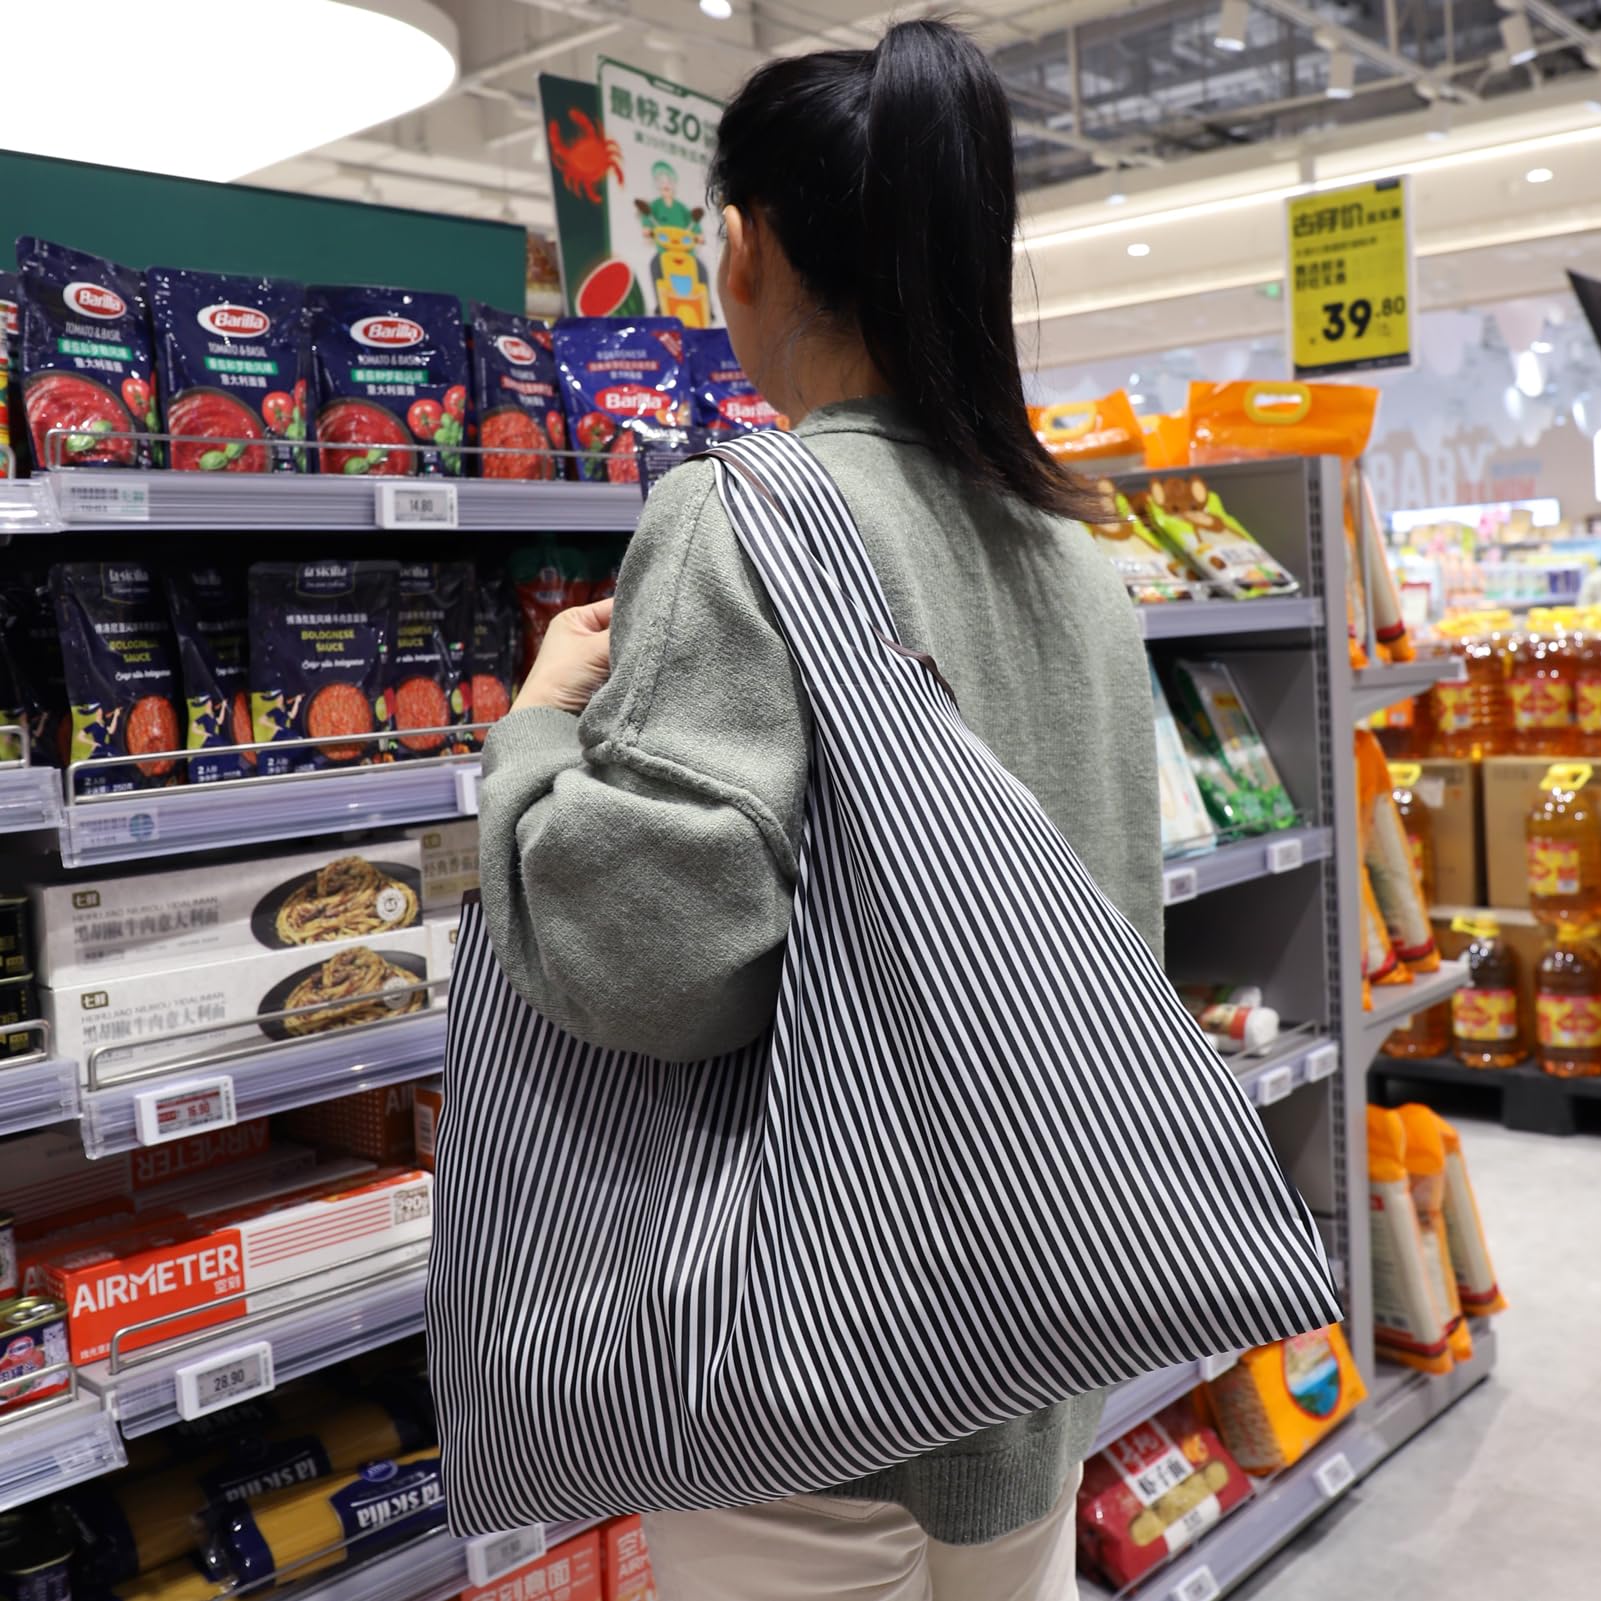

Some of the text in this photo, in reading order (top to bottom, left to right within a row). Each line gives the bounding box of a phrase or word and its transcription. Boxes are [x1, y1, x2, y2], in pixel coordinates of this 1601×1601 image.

[79, 290, 121, 312] Barilla
[214, 311, 264, 329] Barilla
[368, 323, 418, 339] Barilla
[605, 392, 662, 410] Barilla
[83, 1000, 225, 1044] 黑胡椒牛肉意大利面
[72, 1243, 240, 1319] AIRMETER
[214, 1369, 245, 1392] 28.90
